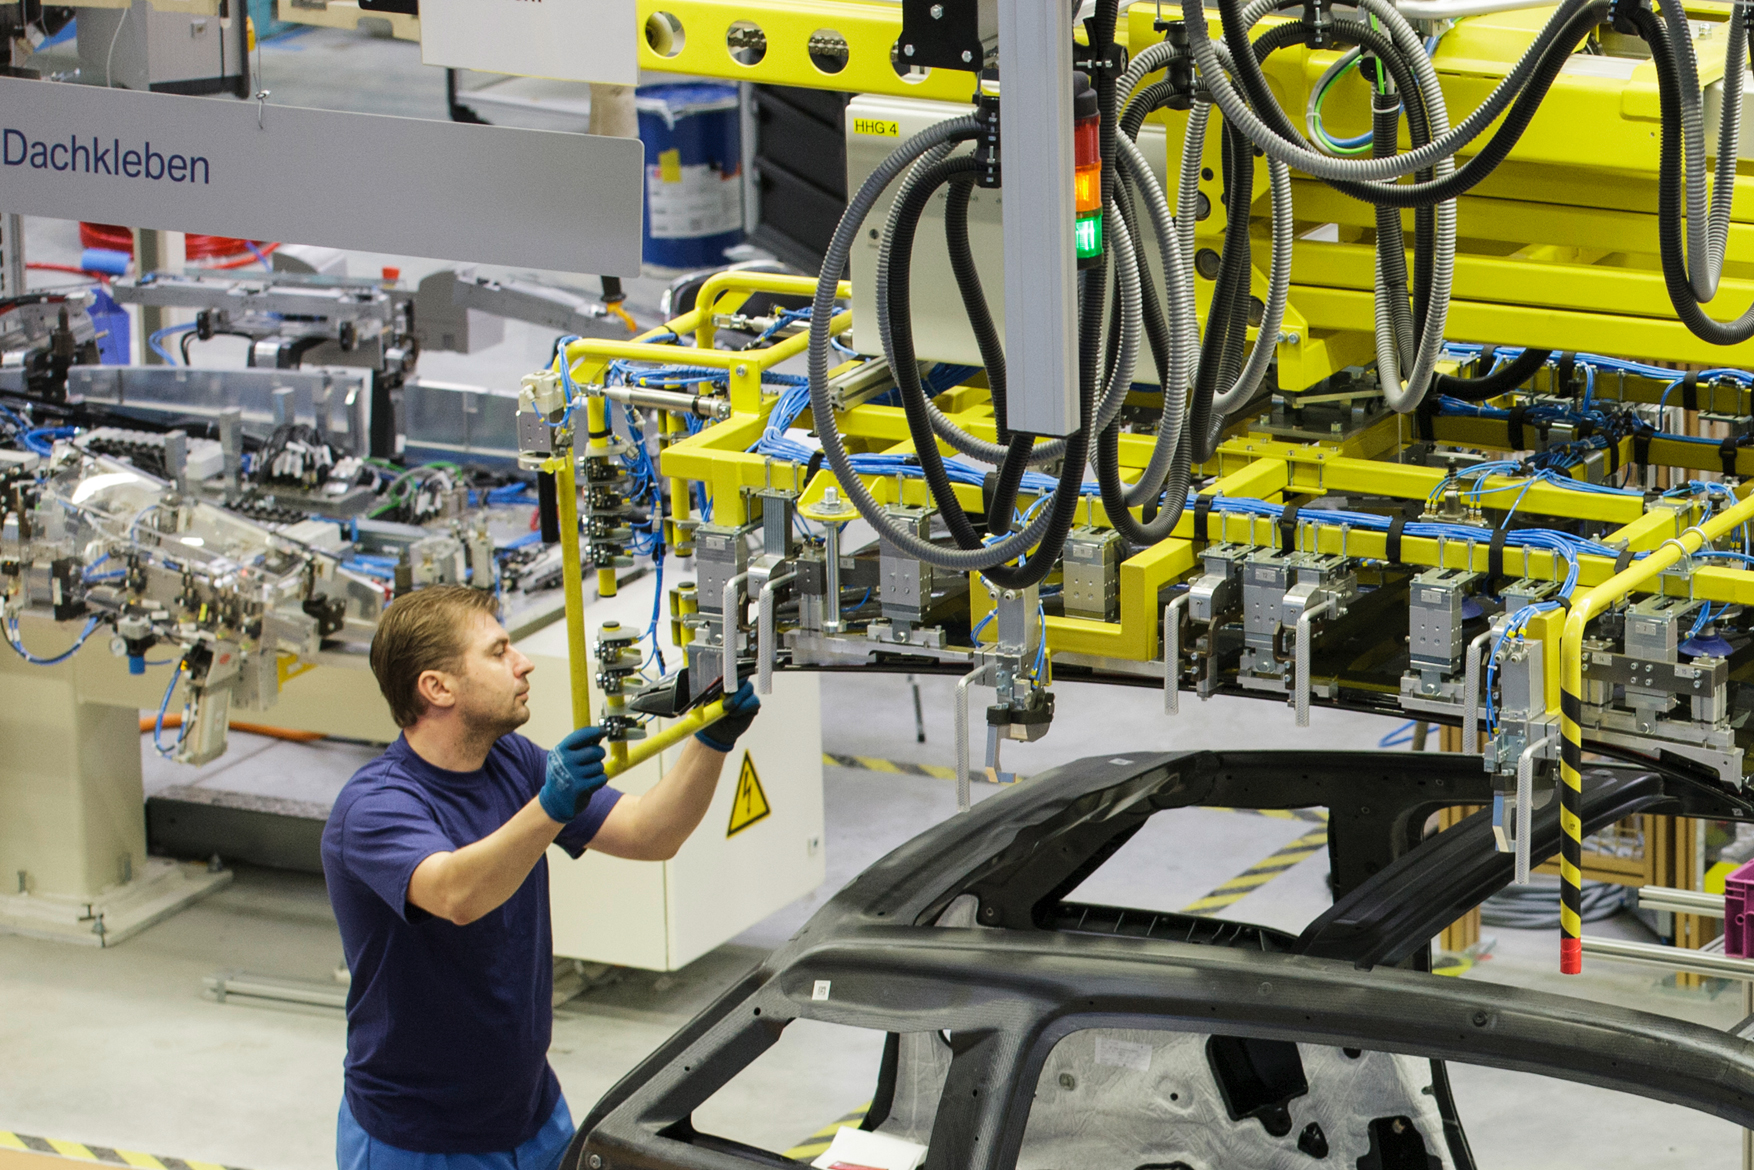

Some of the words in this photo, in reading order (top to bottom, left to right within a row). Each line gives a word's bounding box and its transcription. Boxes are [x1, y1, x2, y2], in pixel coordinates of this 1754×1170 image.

[855, 120, 885, 134] HHG
[889, 123, 897, 135] 4
[3, 128, 210, 184] Dachkleben
